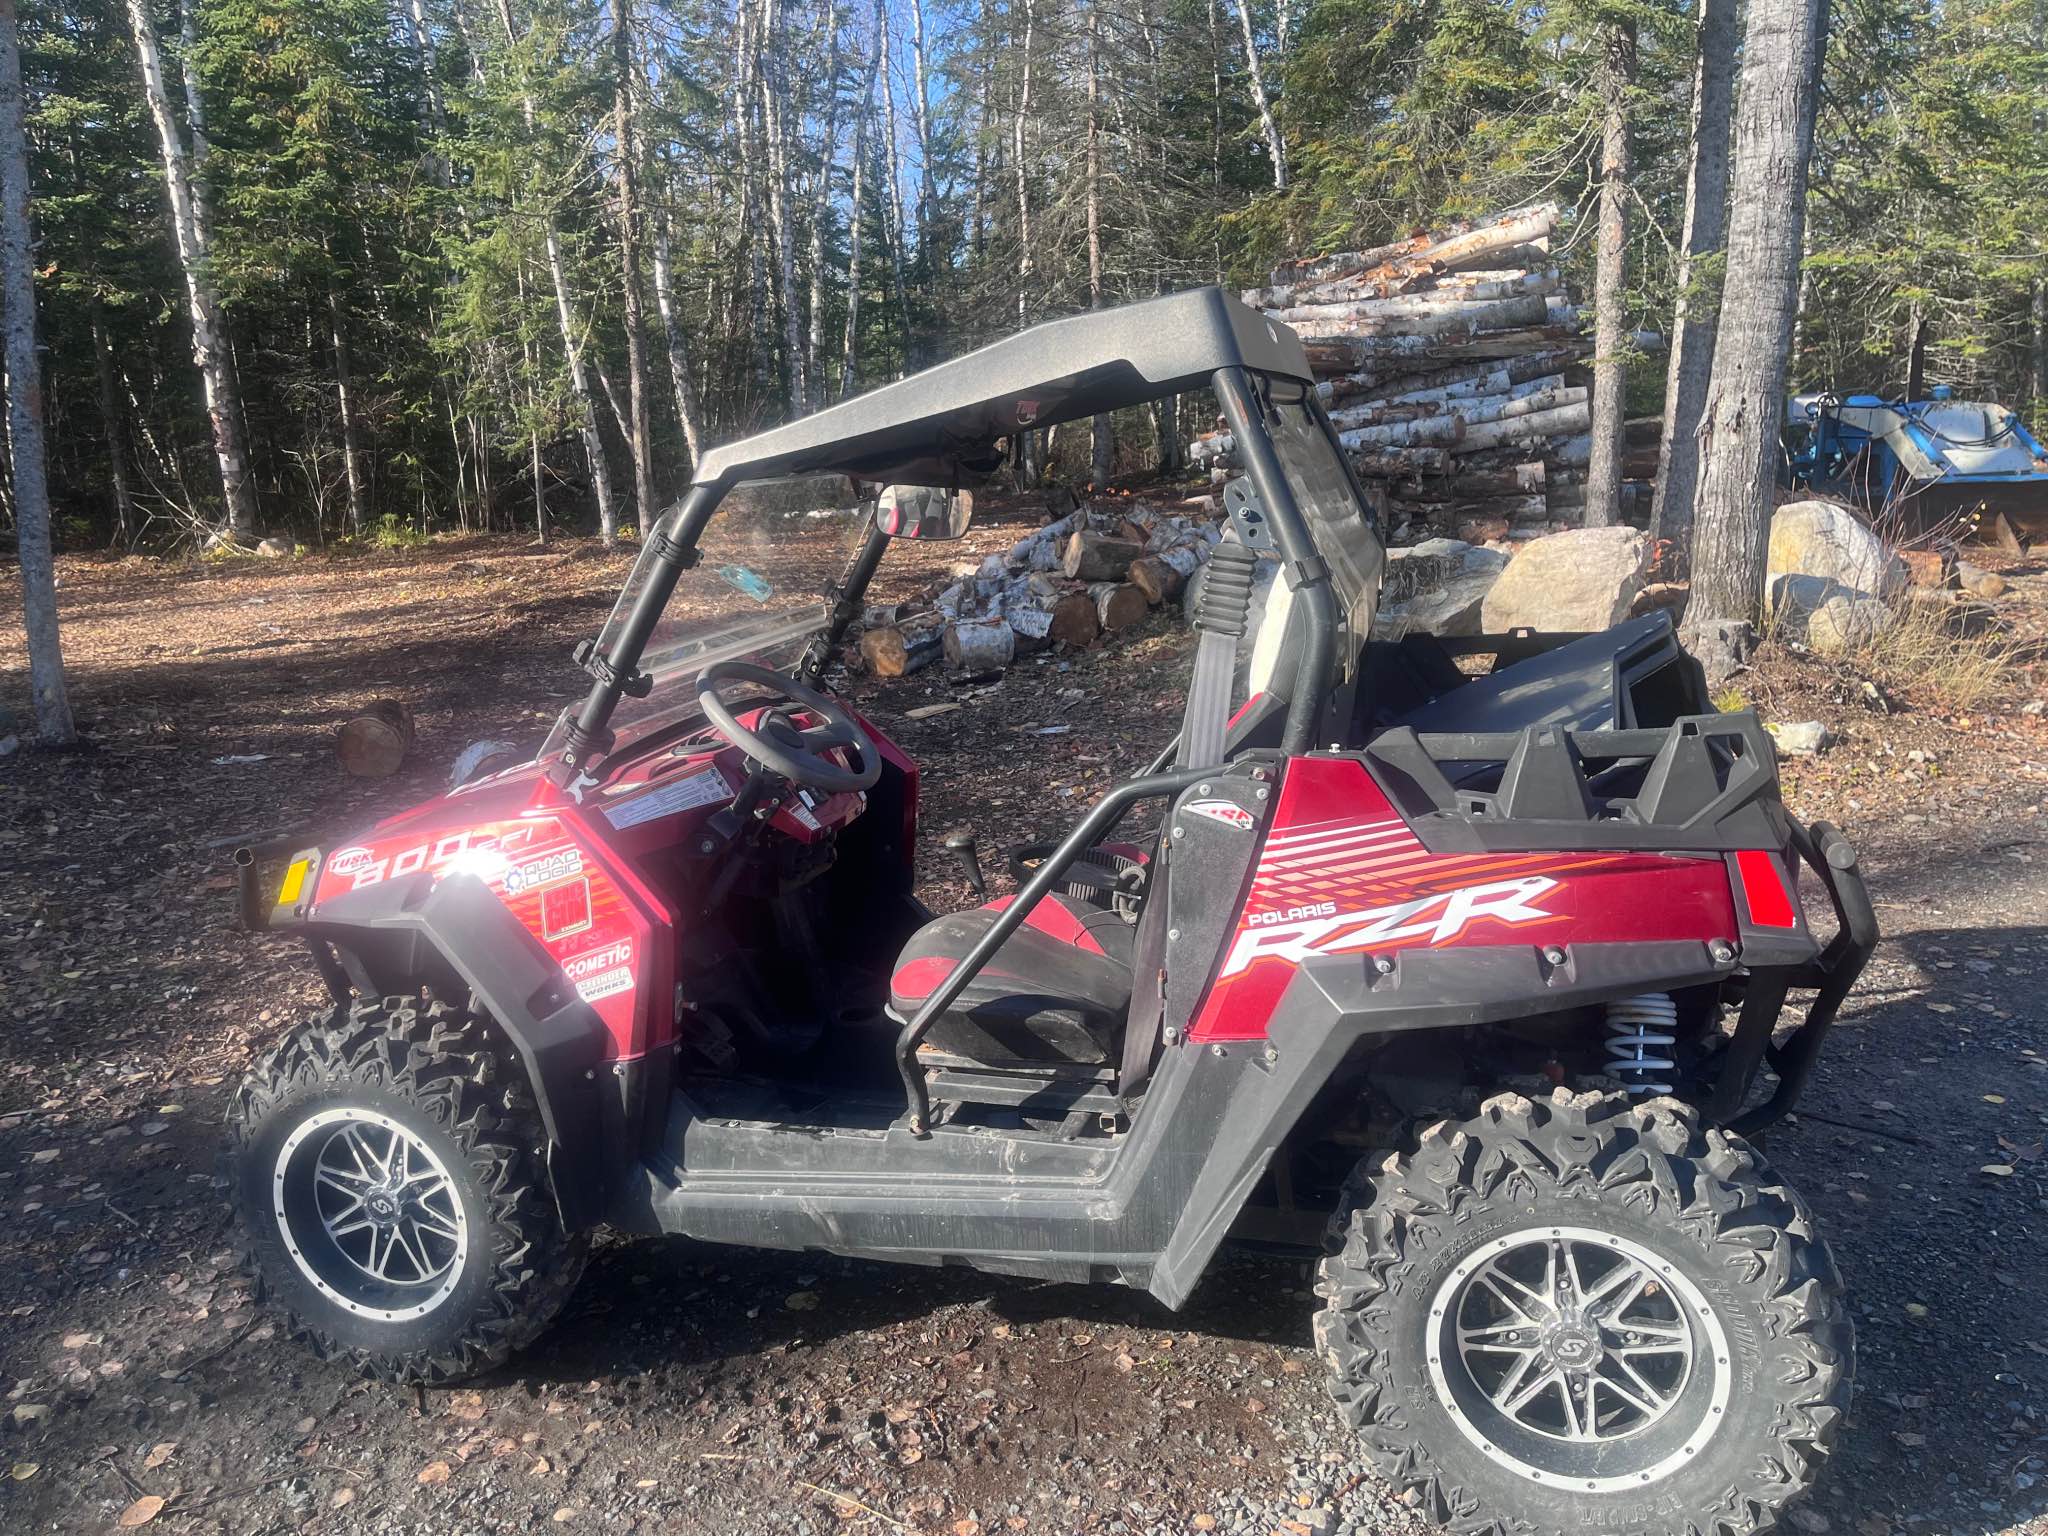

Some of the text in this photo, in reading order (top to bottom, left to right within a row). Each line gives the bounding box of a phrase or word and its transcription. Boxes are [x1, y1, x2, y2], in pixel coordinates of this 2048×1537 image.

[330, 851, 373, 871] TUSK
[352, 831, 473, 890] 800
[524, 850, 577, 875] QUAD
[525, 861, 581, 887] LOGIC
[1248, 902, 1337, 926] POLARIS
[1220, 876, 1558, 978] RZR
[565, 943, 631, 978] COMETIC
[585, 980, 626, 997] WORKS
